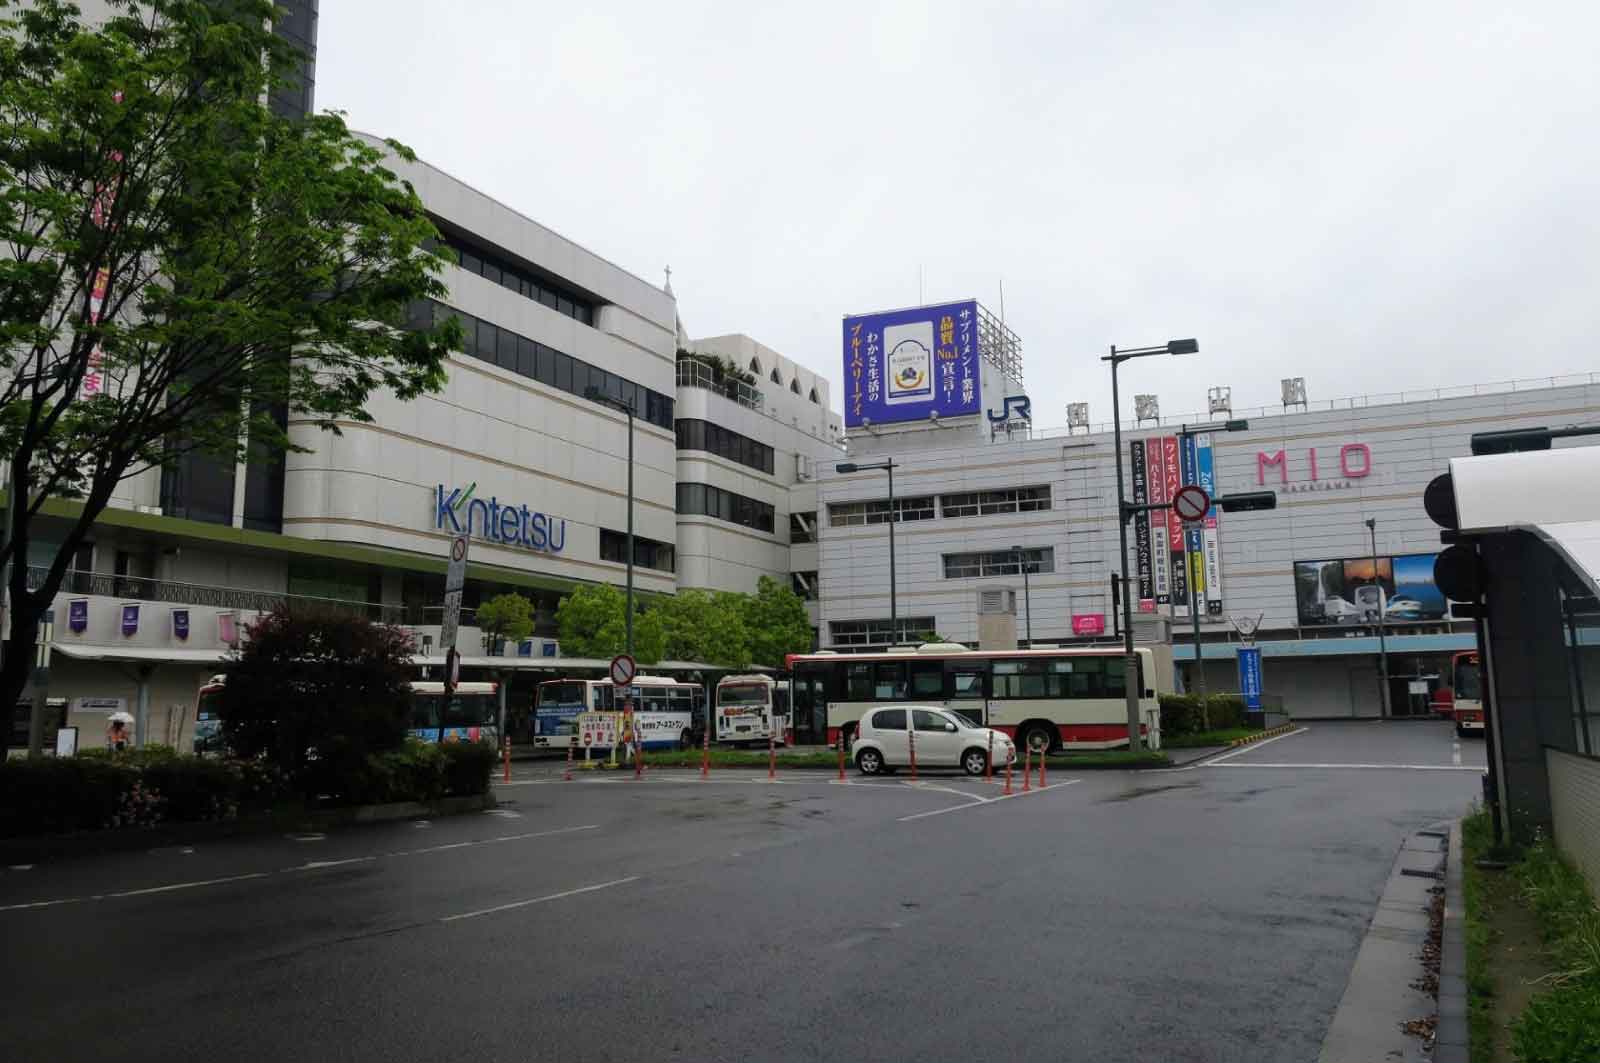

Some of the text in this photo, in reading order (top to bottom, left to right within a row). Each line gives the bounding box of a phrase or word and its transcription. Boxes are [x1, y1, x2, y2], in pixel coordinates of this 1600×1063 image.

[866, 332, 881, 402] わかさ生活の
[959, 308, 974, 405] サプリメント業界
[987, 395, 1032, 422] JR
[1256, 443, 1371, 486] MIO
[436, 482, 566, 552] Kintetsu
